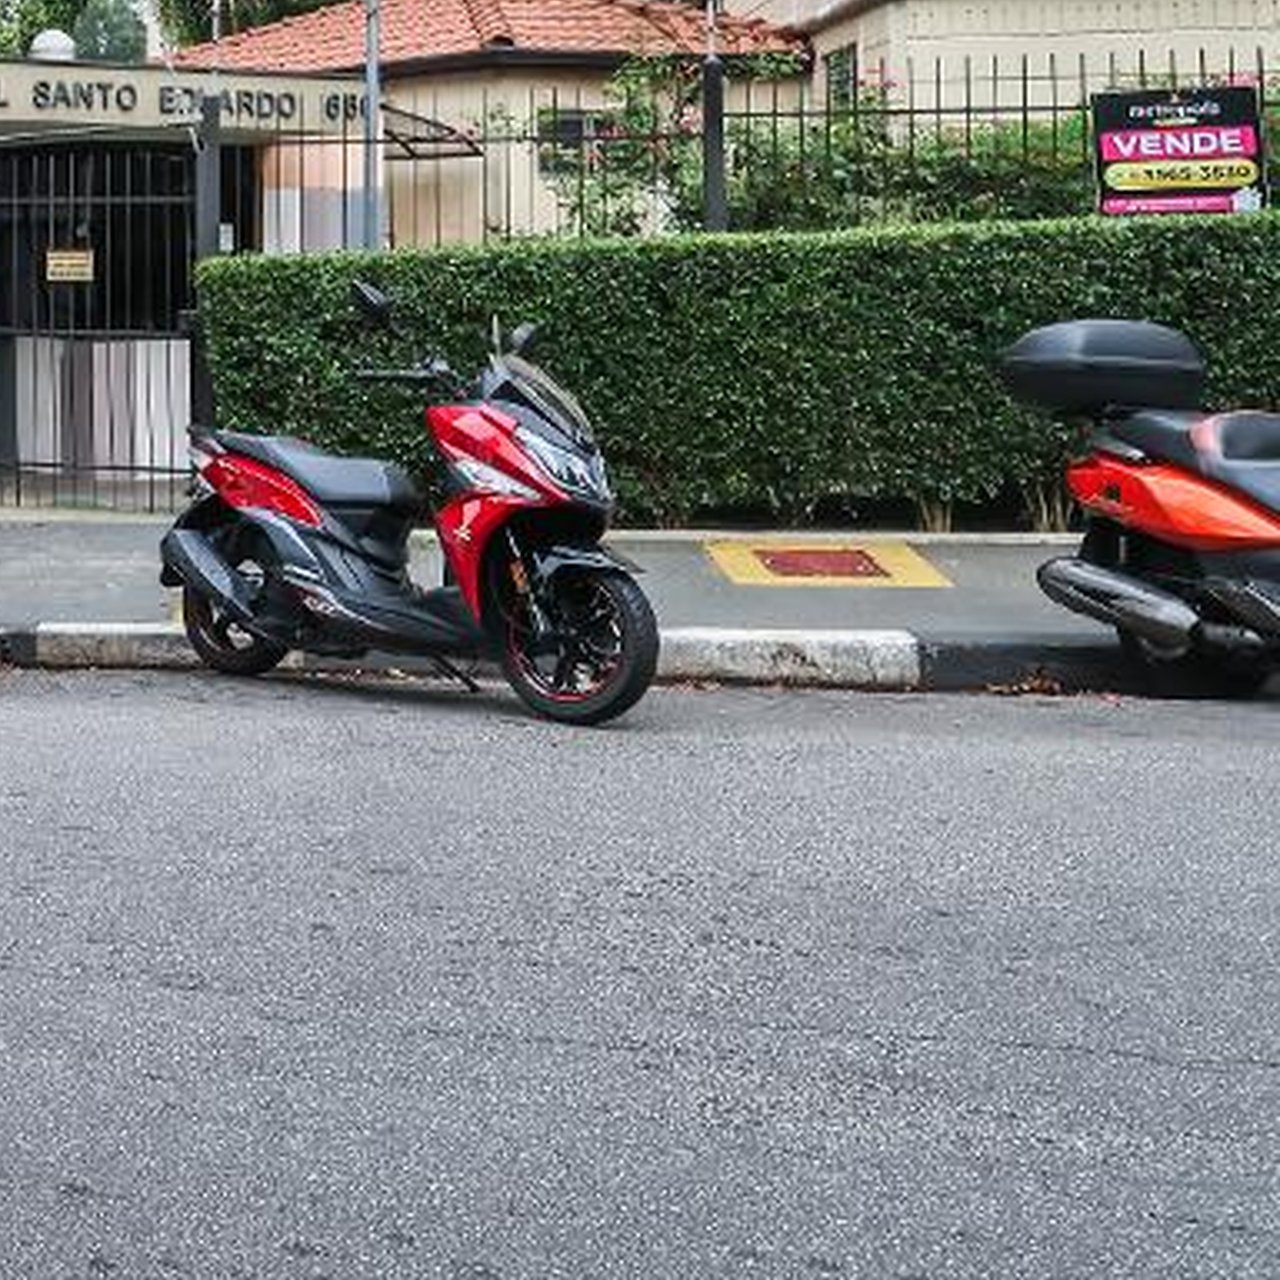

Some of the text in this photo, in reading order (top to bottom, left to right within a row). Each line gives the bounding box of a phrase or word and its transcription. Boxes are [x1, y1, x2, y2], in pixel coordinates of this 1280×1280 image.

[32, 82, 137, 111] SANTO
[159, 86, 296, 119] EDARDO
[1111, 128, 1245, 157] VENDE
